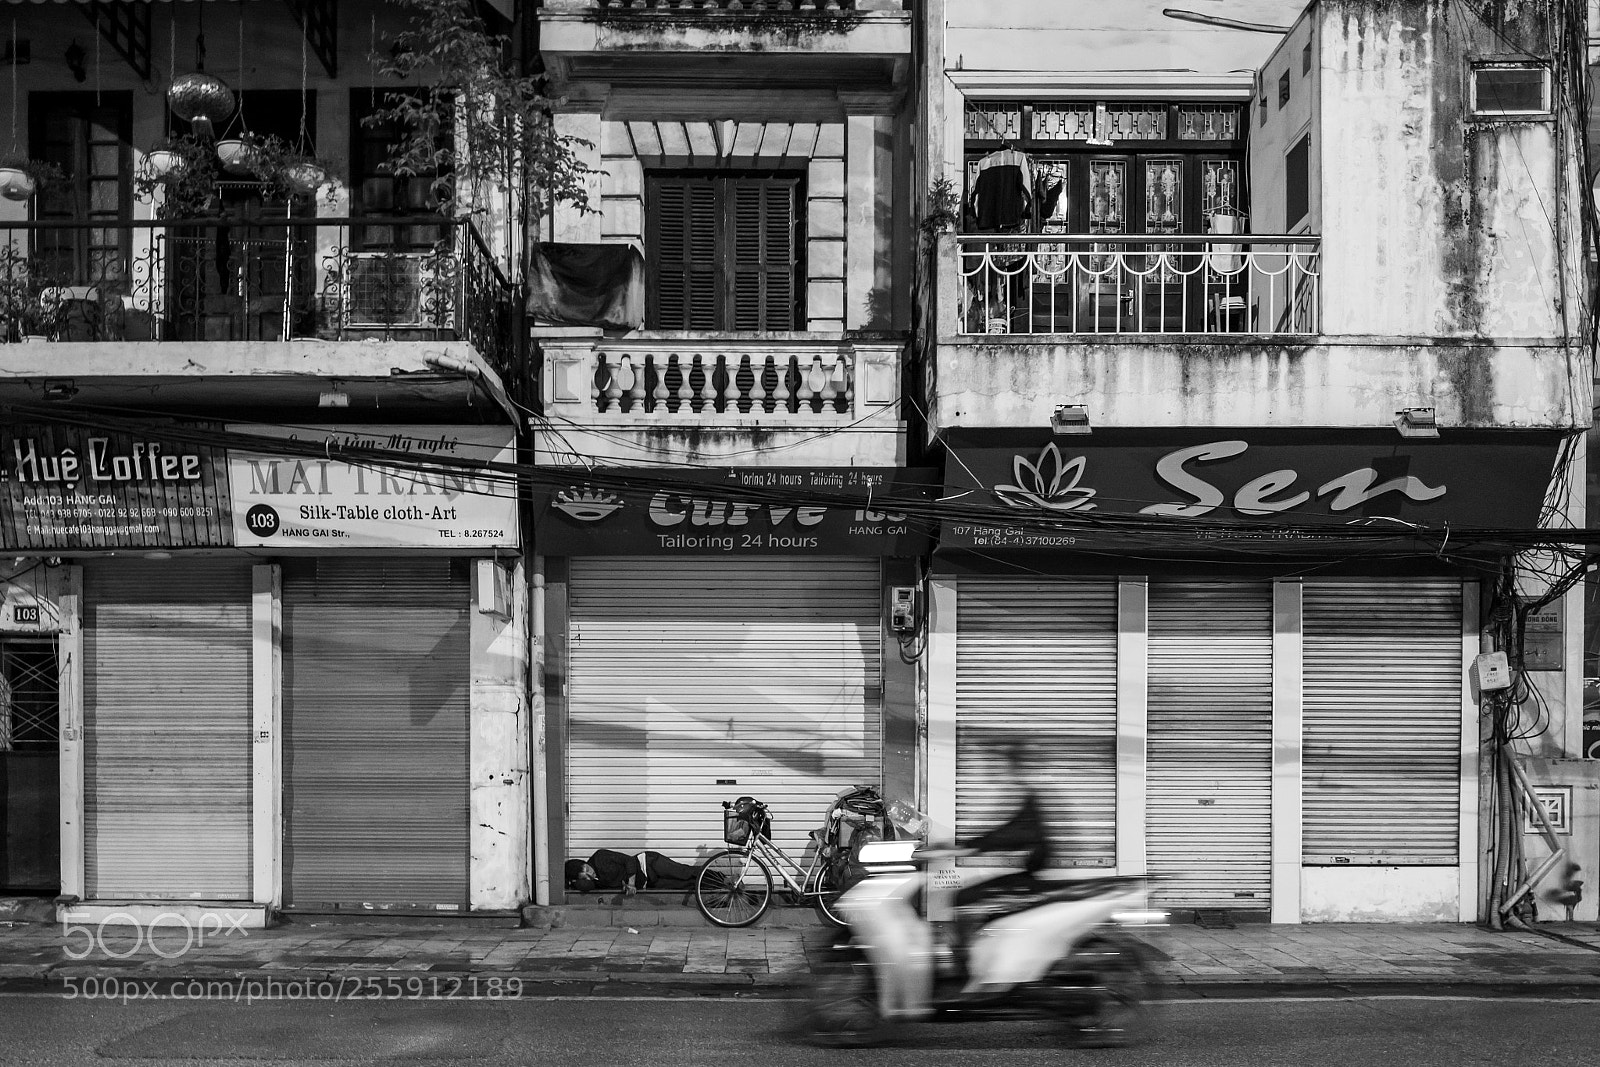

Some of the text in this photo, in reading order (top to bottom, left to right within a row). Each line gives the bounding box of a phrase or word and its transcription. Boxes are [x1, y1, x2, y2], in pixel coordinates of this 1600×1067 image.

[88, 437, 200, 481] Coffee
[247, 458, 497, 496] MAI TRANG
[767, 472, 777, 485] 24
[780, 473, 802, 486] hours
[810, 471, 843, 488] Tailoring
[848, 472, 858, 485] 24
[1138, 440, 1447, 517] Sen
[98, 494, 116, 505] GAI
[98, 507, 116, 518] 0122
[117, 507, 128, 518] 92
[129, 507, 139, 517] 92
[162, 507, 178, 517] 090
[180, 507, 194, 517] 600
[195, 506, 213, 517] 8251
[299, 505, 457, 520] Silk-Table cloth-Art
[250, 513, 275, 528] 103
[312, 528, 329, 537] GAI
[464, 529, 504, 538] 8.267524
[849, 526, 907, 535] HANG GAI
[952, 526, 971, 535] 107
[1005, 526, 1024, 535] Gai
[657, 534, 818, 551] Tailoring 24 hours
[1025, 536, 1076, 545] 37100269
[16, 608, 37, 621] 103
